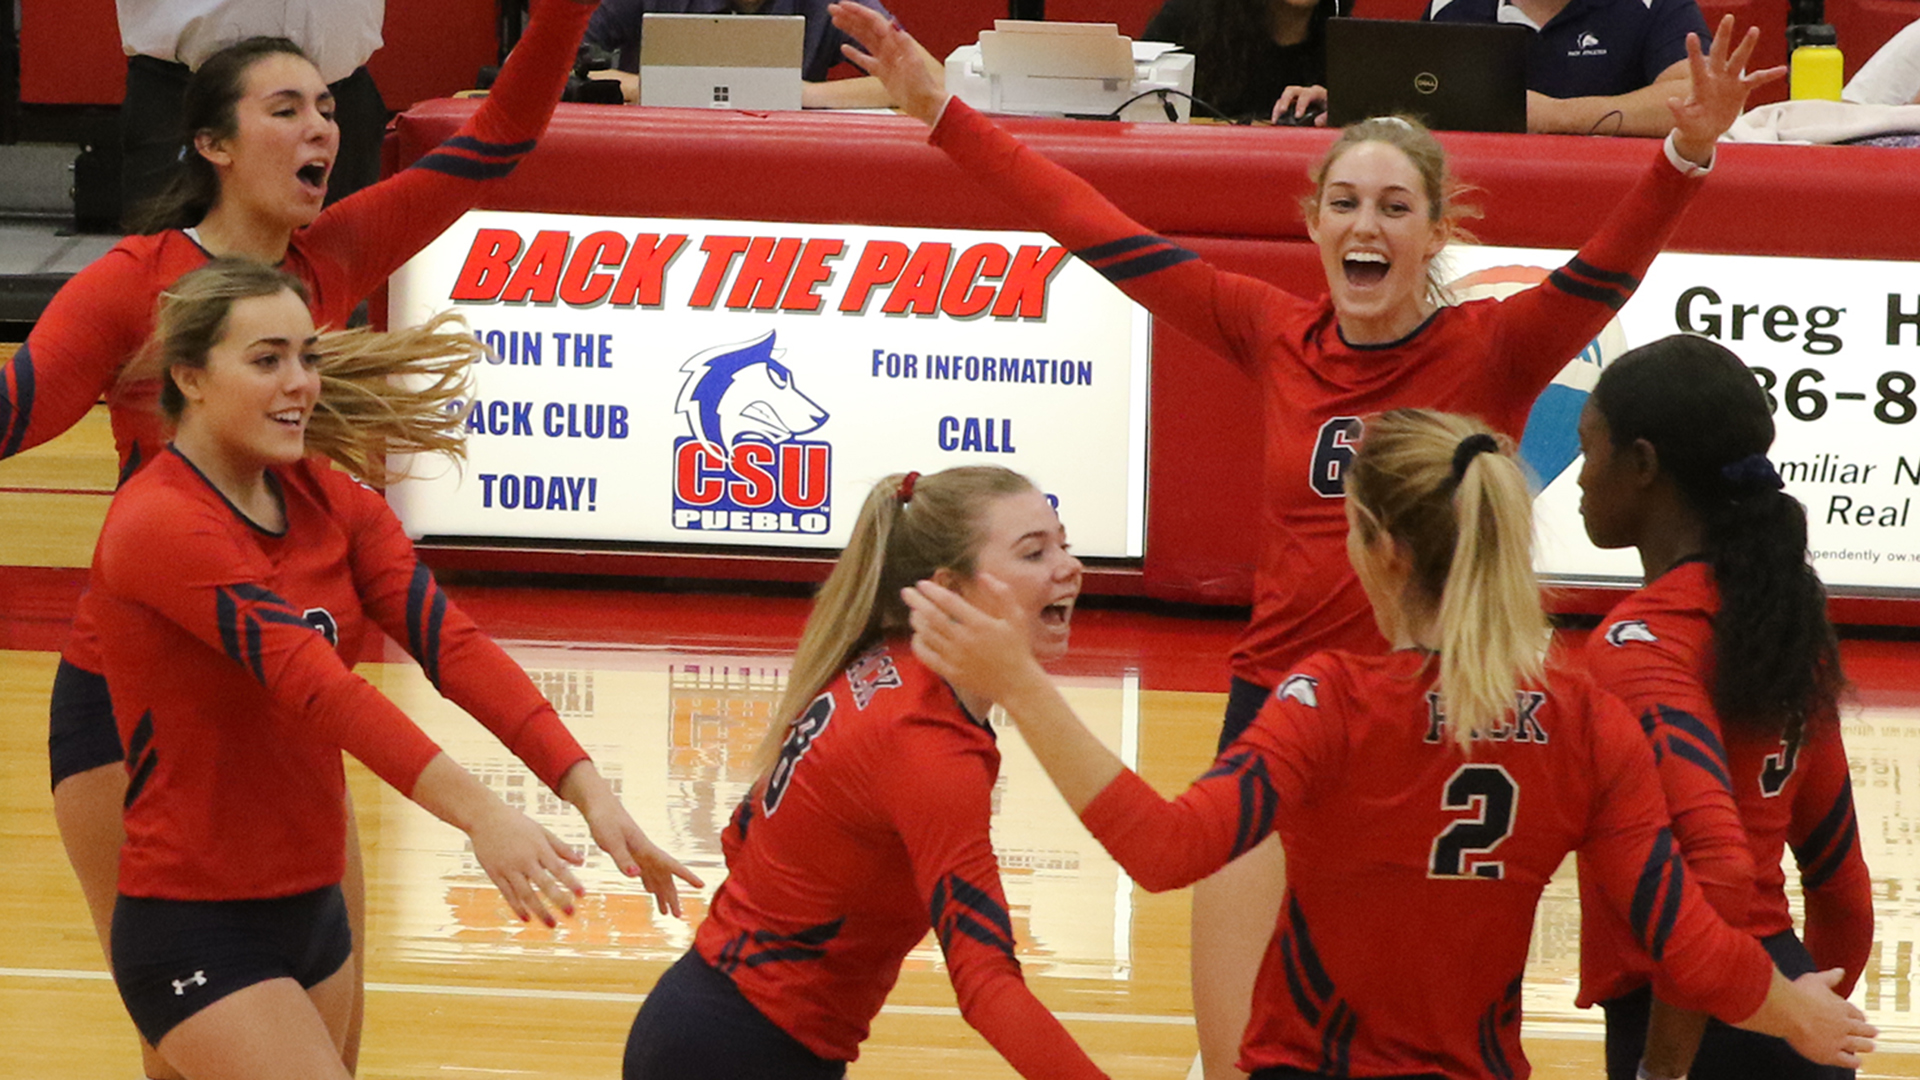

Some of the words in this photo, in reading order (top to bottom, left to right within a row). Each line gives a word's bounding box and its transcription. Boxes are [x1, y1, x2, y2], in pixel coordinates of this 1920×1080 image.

[449, 228, 692, 309] BACK
[687, 235, 849, 315] THE
[837, 240, 1073, 322] PACK
[1674, 286, 1847, 355] Greg
[471, 330, 542, 367] JOIN
[552, 332, 613, 368] THE
[871, 348, 918, 379] FOR
[926, 354, 1093, 387] INFORMATION
[543, 402, 630, 439] CLUB
[938, 415, 1016, 453] CALL
[675, 440, 829, 509] CSU
[1309, 416, 1364, 498] 6
[1778, 454, 1877, 485] miliar
[478, 473, 598, 512] TODAY!
[1826, 495, 1911, 527] Real
[674, 508, 827, 533] PUEBLO
[1813, 548, 1881, 564] pendently
[762, 692, 836, 819] 8
[1426, 763, 1519, 880] 2
